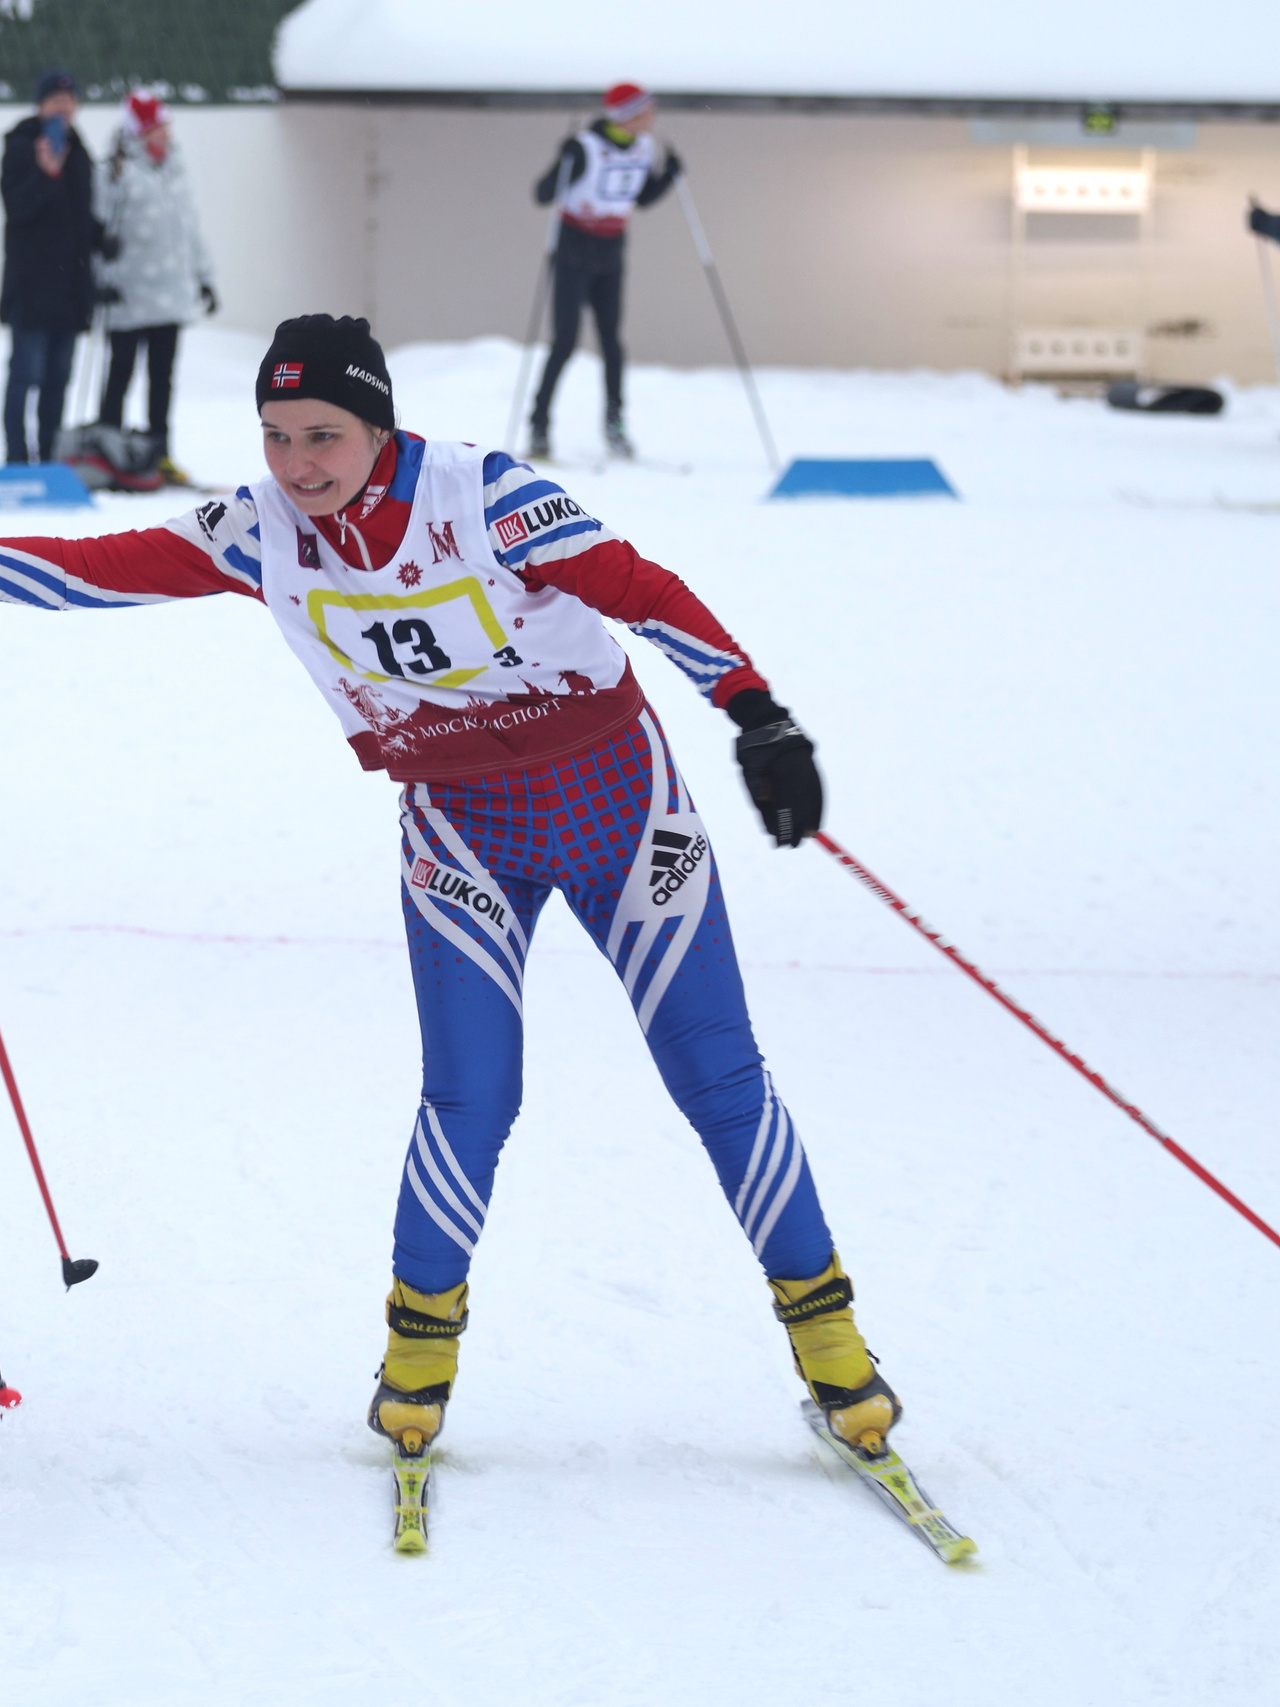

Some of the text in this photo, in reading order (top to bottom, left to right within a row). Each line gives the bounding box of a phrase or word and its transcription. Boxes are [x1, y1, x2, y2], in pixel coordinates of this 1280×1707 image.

[345, 364, 390, 396] MADSHUS
[360, 618, 452, 678] 13
[492, 646, 524, 668] 3
[652, 833, 707, 906] adidas
[428, 867, 506, 930] LUKOIL
[779, 1290, 845, 1319] SALOMON
